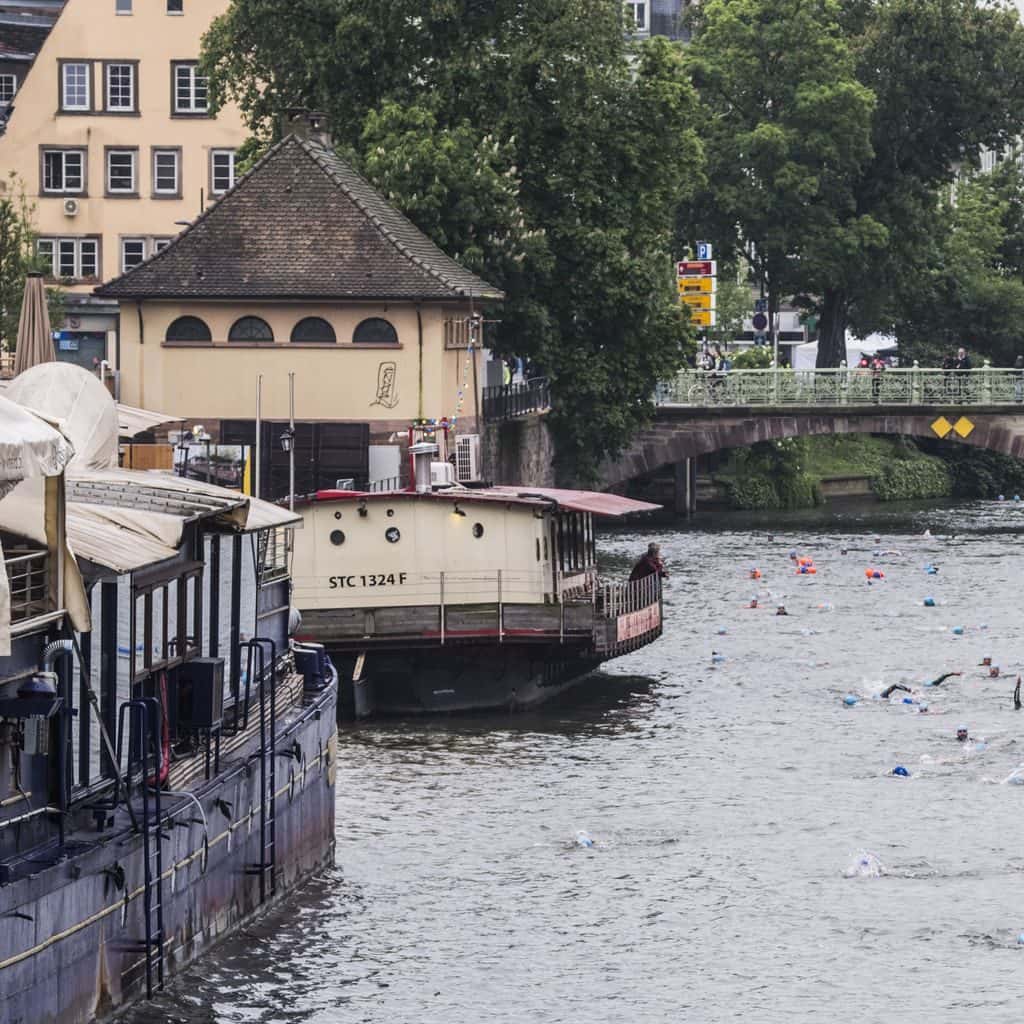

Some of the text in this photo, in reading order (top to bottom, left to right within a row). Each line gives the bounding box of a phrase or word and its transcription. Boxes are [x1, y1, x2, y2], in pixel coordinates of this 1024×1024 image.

[329, 572, 407, 589] STC 1324 F
